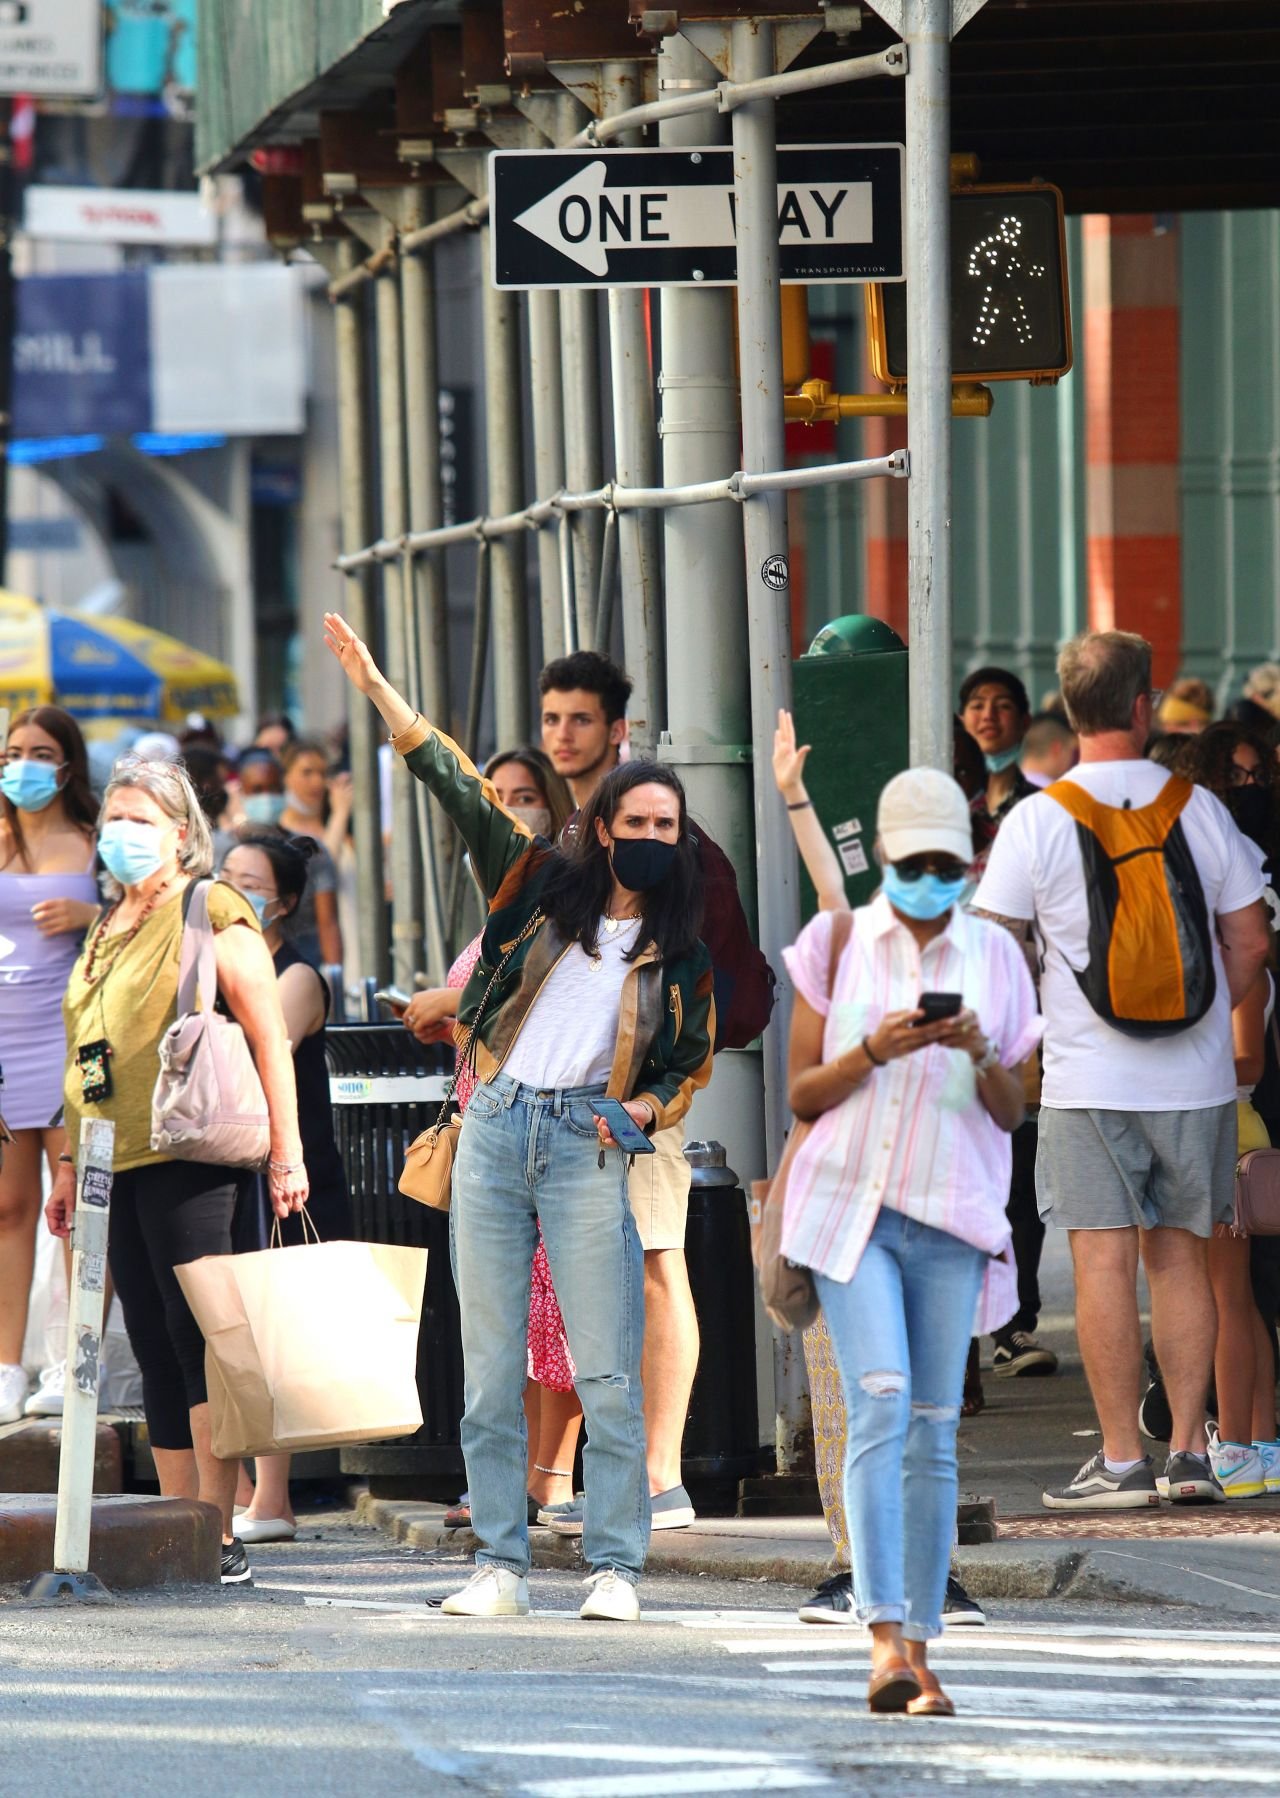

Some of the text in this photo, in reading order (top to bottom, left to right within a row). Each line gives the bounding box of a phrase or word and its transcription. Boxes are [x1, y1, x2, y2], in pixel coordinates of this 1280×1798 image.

[558, 189, 848, 244] ONE AY
[794, 266, 886, 274] TRANSPORTATION
